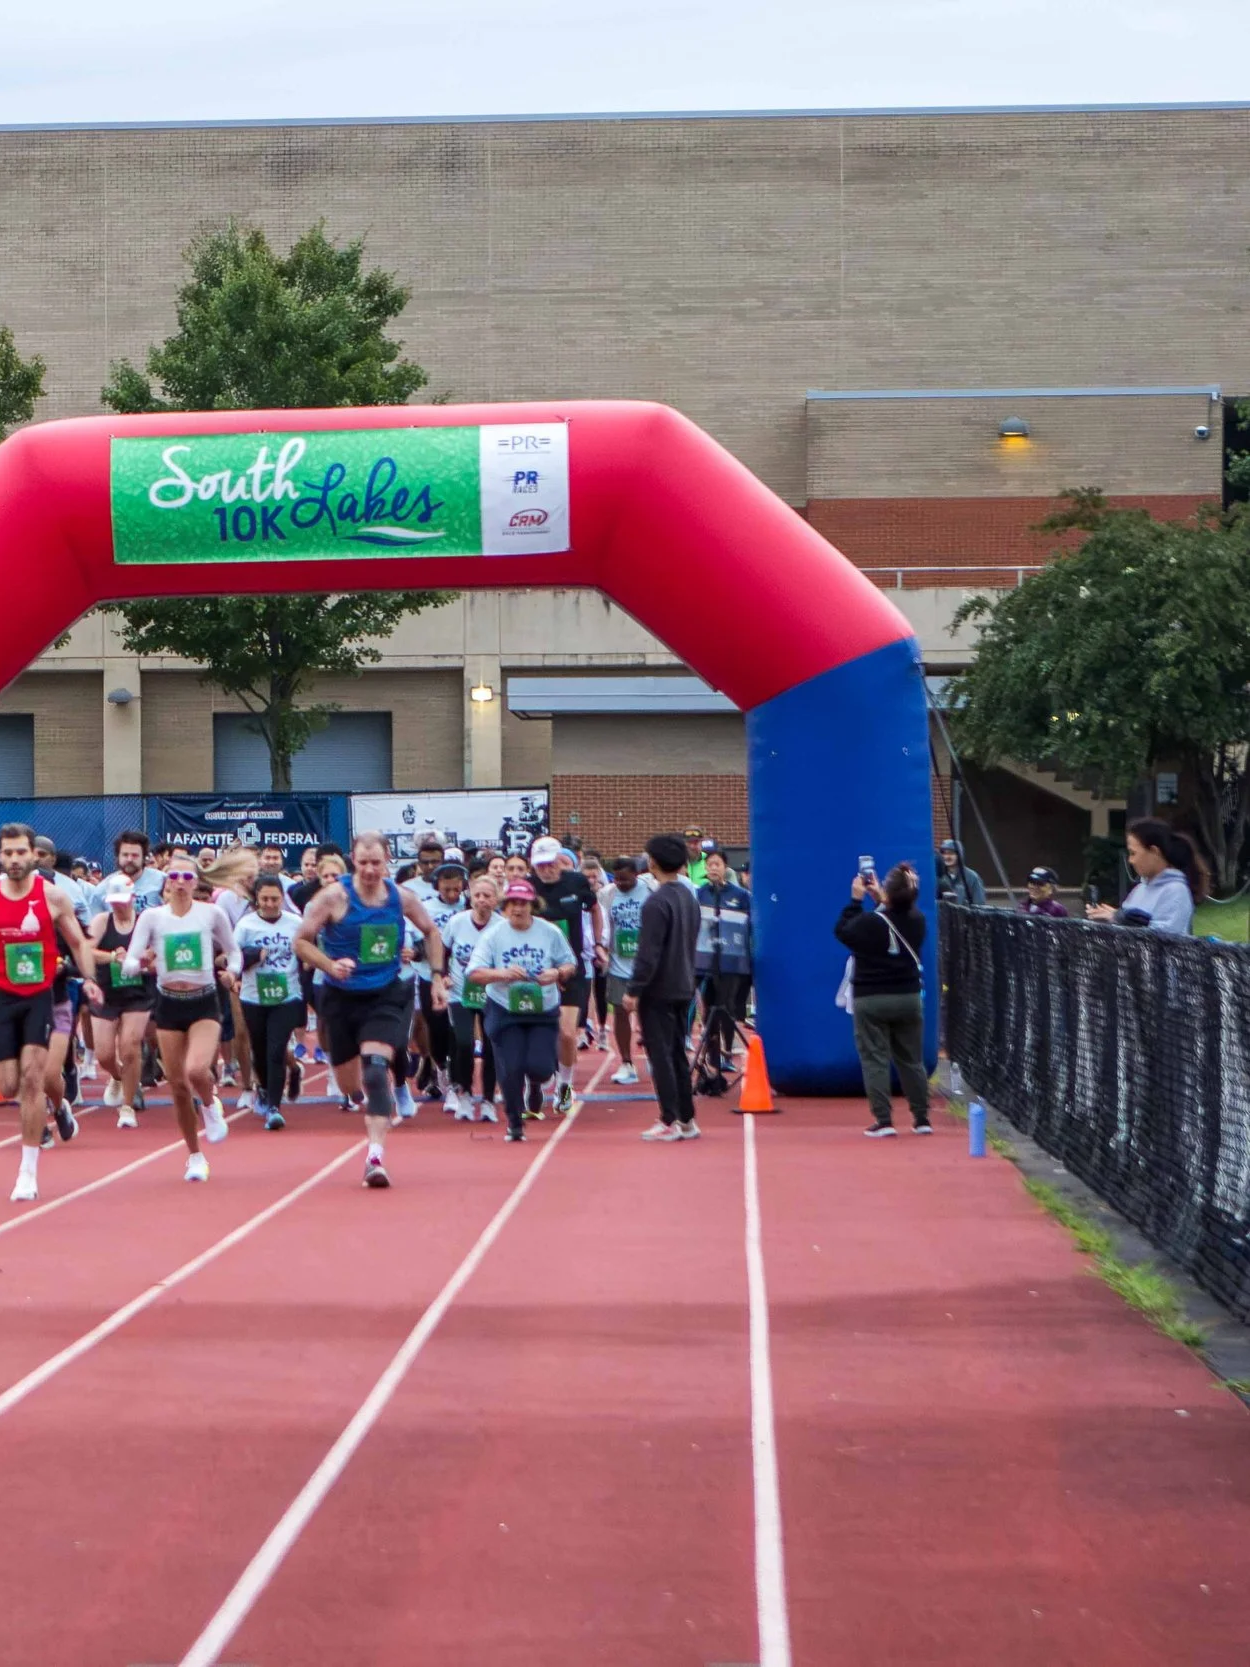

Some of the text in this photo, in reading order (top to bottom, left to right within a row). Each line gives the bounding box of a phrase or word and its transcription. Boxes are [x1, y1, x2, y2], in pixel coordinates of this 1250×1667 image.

[513, 470, 539, 485] PR
[149, 437, 445, 535] South Lakes
[213, 505, 287, 542] 10K
[166, 832, 320, 846] LAFAYETTE FEDERAL
[174, 949, 194, 963] 20
[261, 986, 284, 999] 112
[517, 1000, 536, 1012] 34
